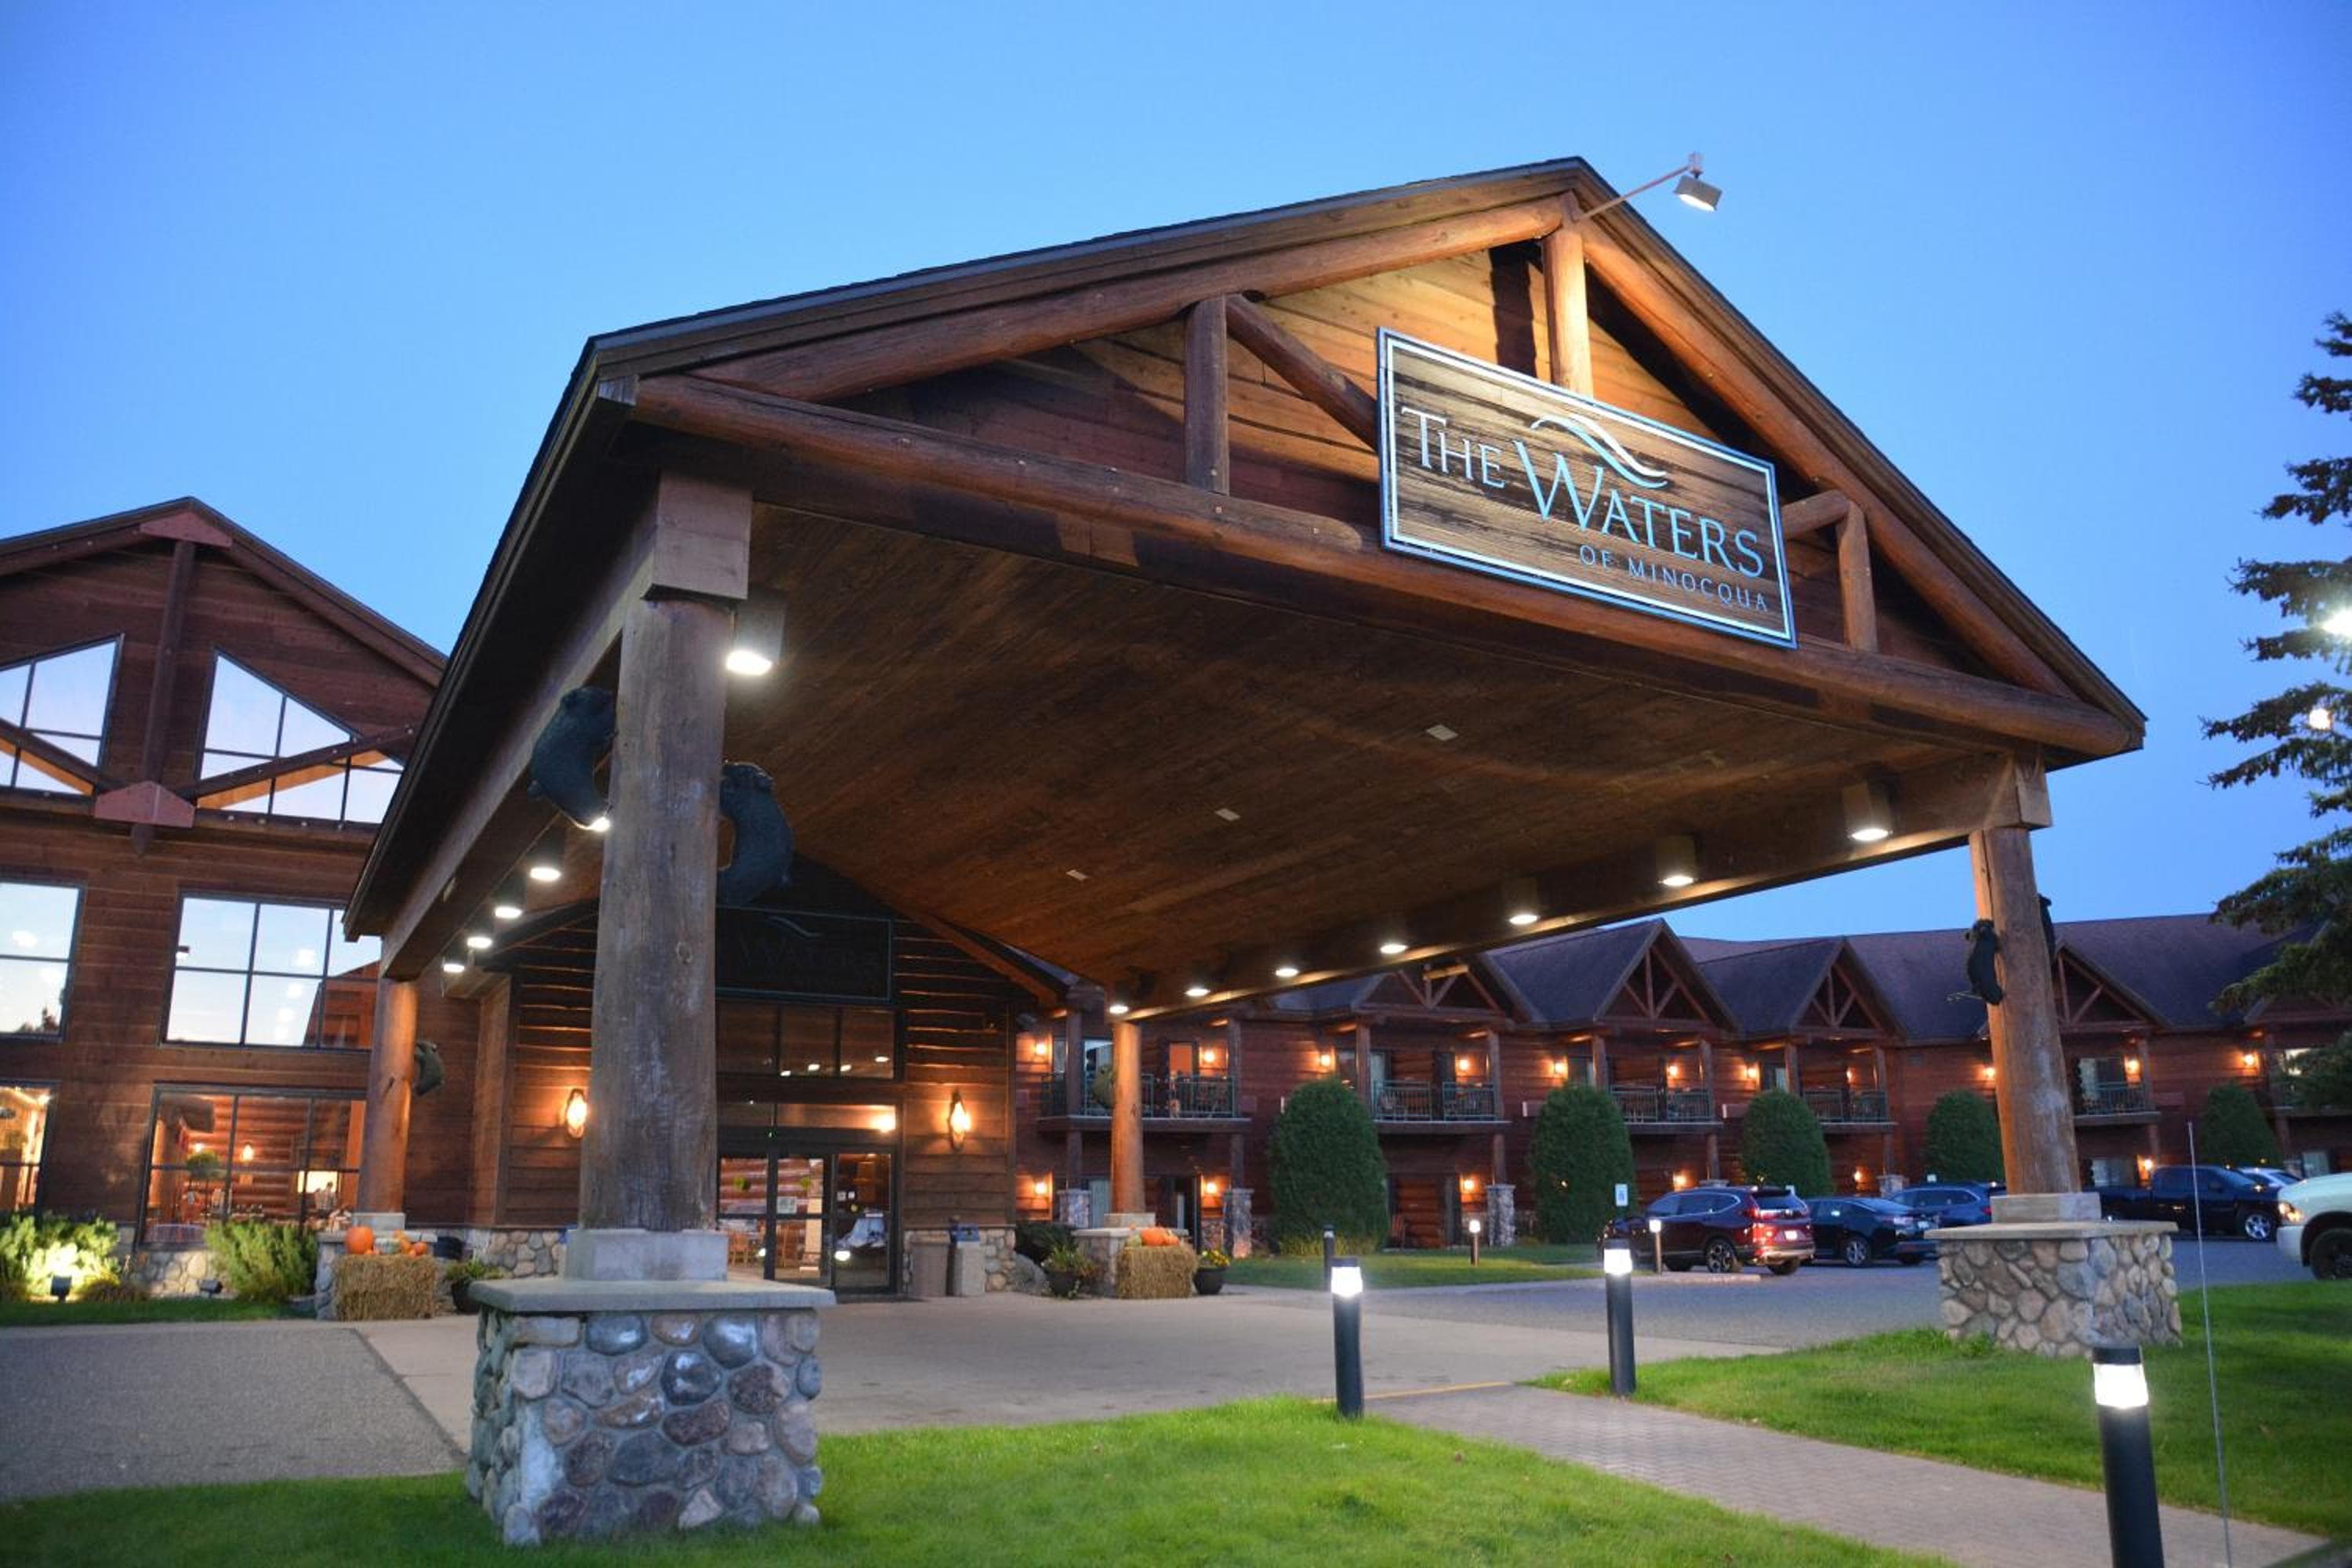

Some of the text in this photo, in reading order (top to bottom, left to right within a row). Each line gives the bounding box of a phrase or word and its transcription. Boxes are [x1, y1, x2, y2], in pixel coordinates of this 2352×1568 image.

[1401, 406, 1763, 578] THE WATERS
[1580, 544, 1768, 612] OF MINOCQUA
